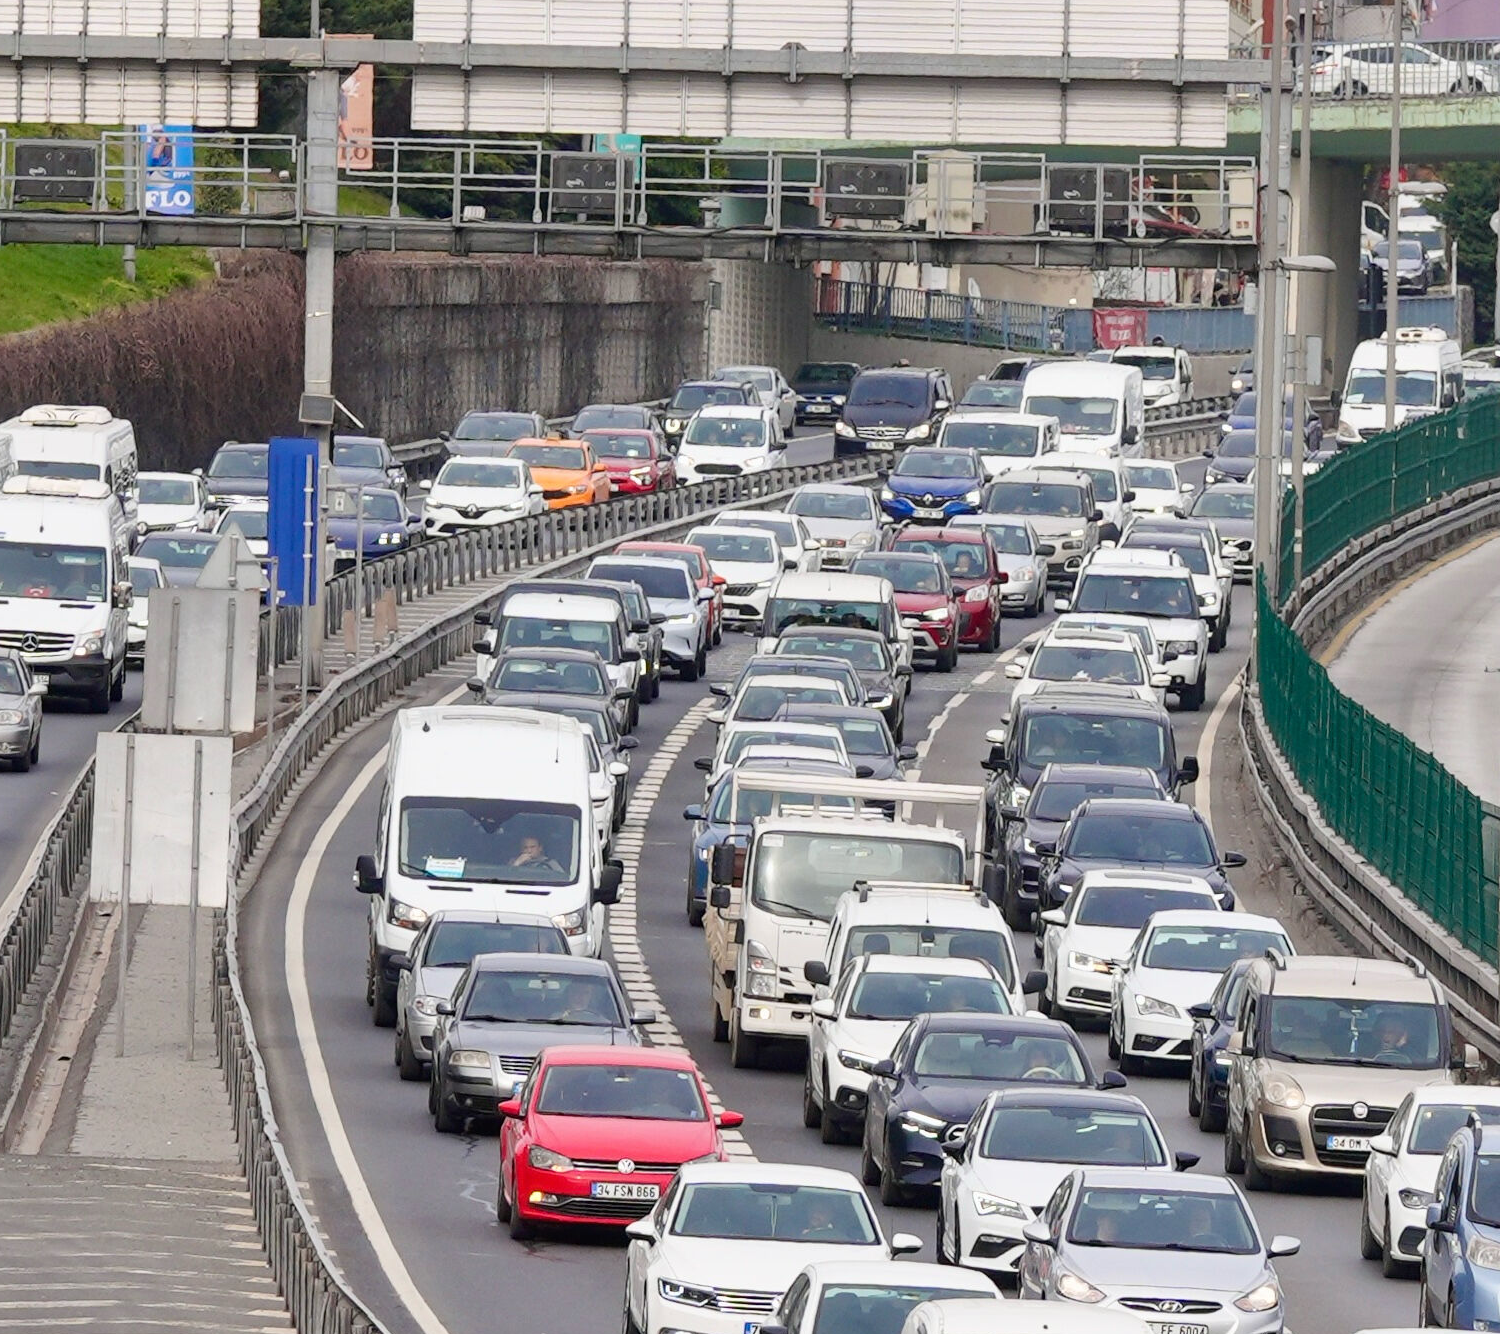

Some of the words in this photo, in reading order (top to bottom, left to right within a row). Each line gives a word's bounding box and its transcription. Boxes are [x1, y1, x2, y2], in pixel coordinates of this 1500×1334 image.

[145, 189, 191, 208] FLO
[597, 1184, 610, 1196] 34
[613, 1185, 634, 1197] FSN
